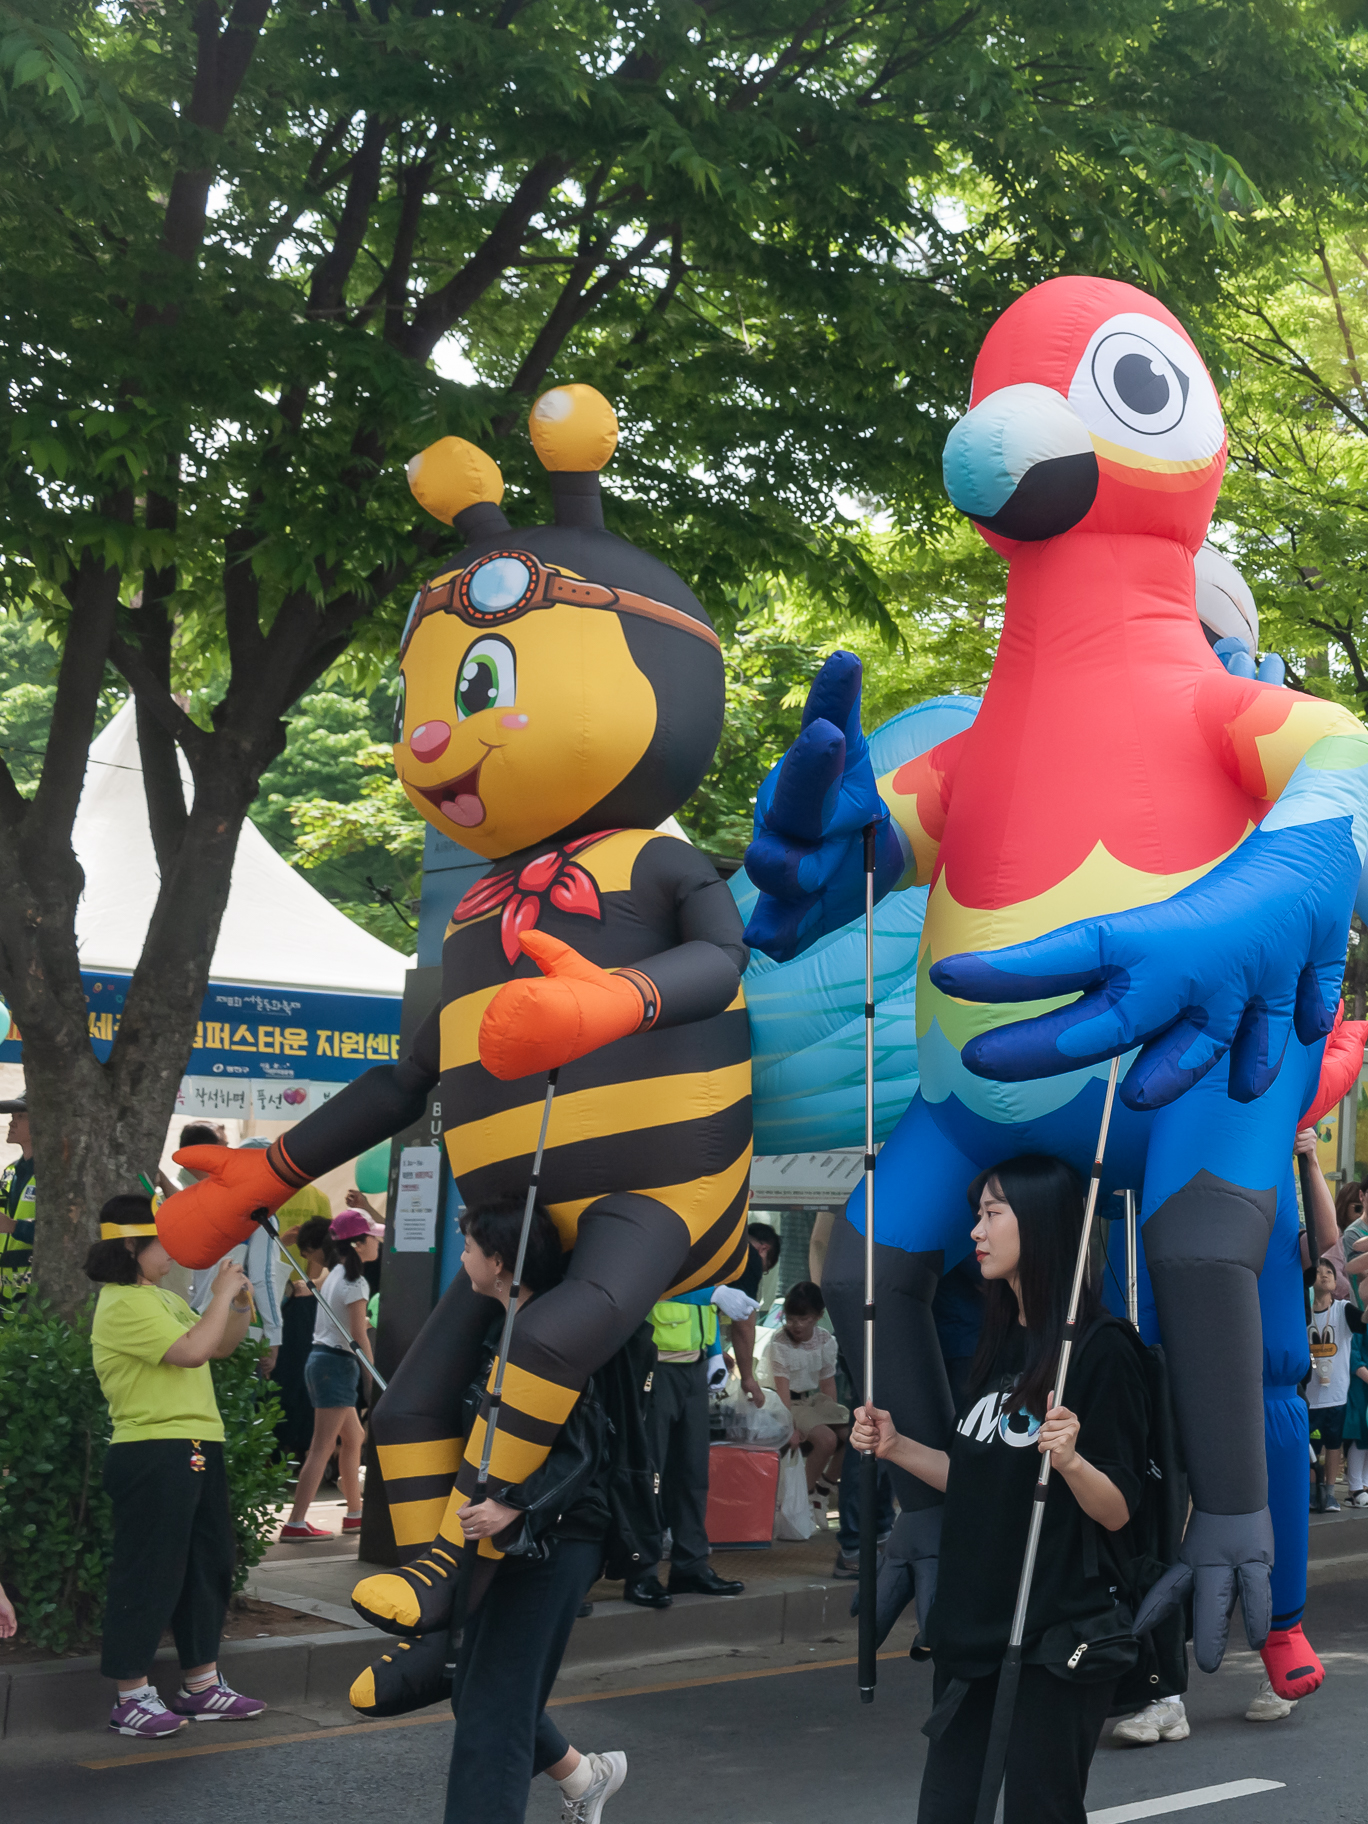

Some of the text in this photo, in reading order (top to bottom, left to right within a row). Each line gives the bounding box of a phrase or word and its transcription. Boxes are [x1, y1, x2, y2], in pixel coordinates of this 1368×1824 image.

[195, 1087, 245, 1110] 작성하면
[257, 1088, 283, 1110] 풍선
[430, 1102, 442, 1148] BUS
[956, 1391, 1042, 1448] MO
